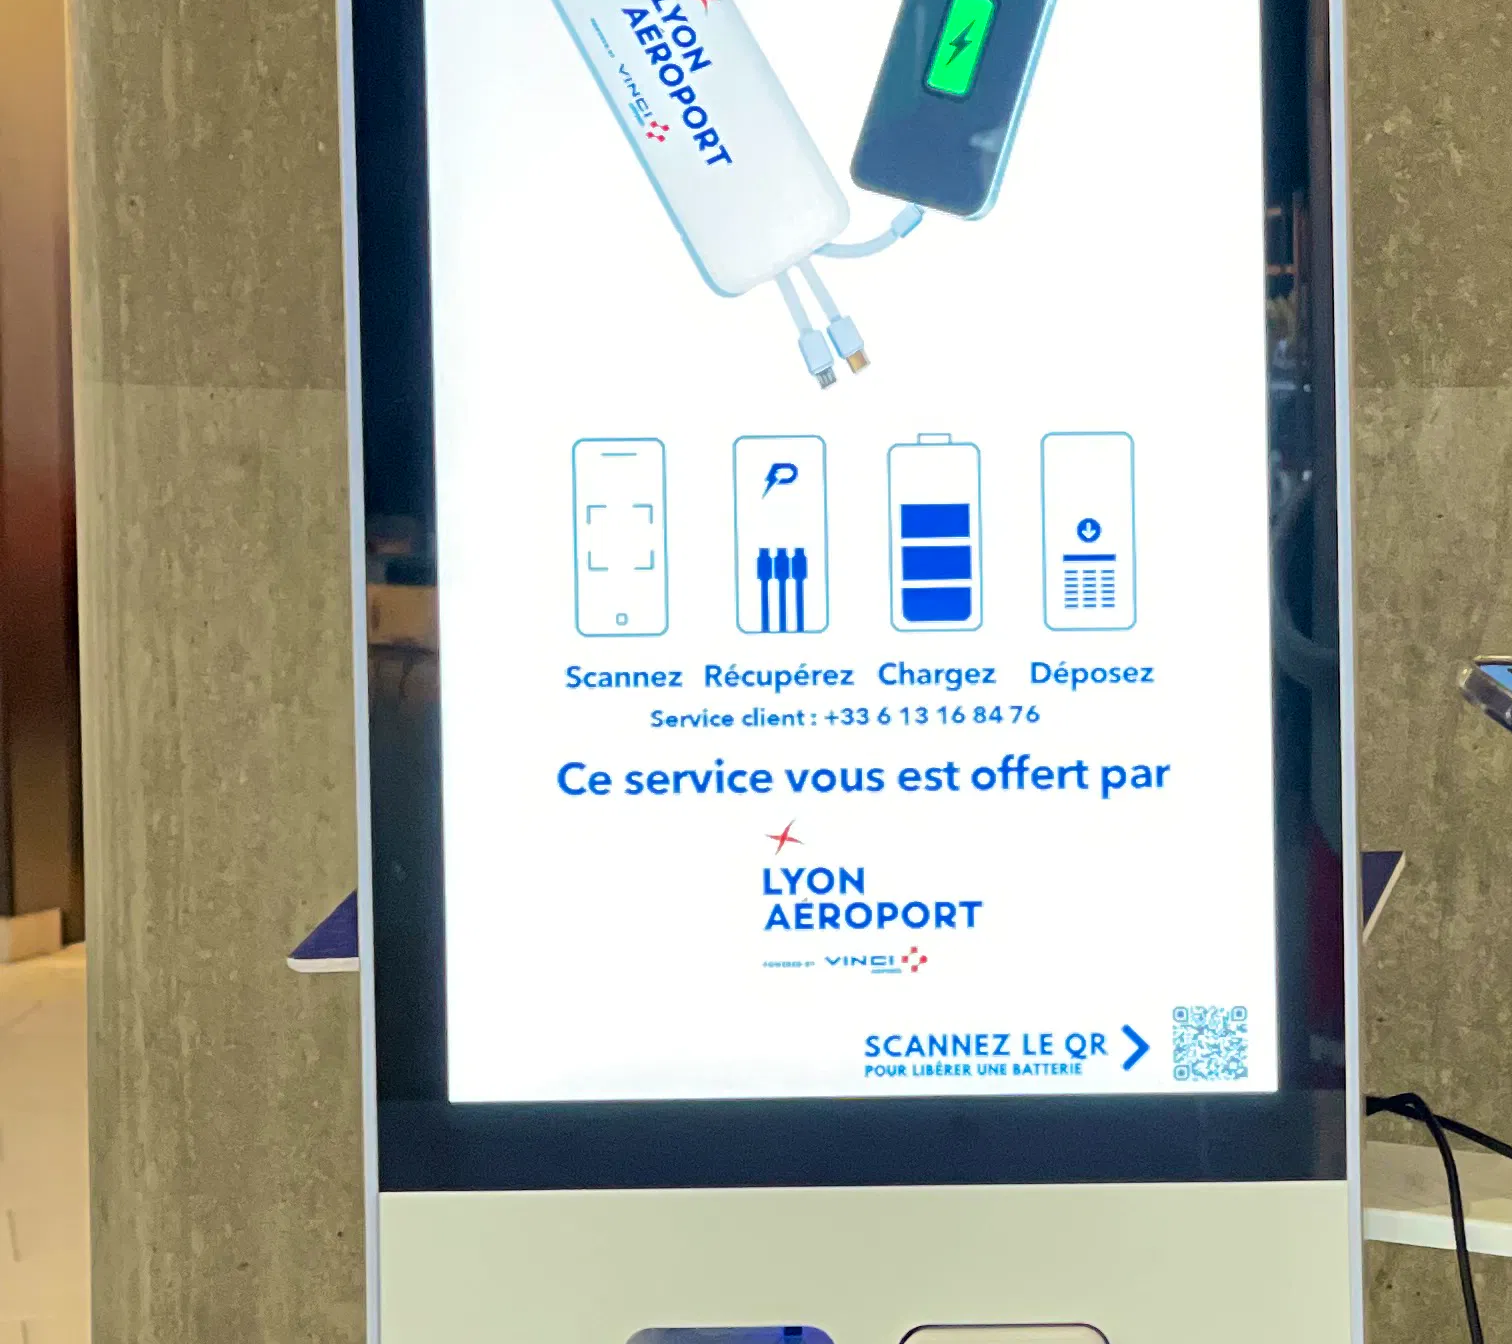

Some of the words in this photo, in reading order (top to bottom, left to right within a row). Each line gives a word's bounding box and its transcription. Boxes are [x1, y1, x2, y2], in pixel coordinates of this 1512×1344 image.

[618, 63, 653, 118] VINCI
[565, 665, 683, 689] Scannez
[704, 663, 855, 694] Récupérez
[878, 661, 997, 692] Chargez
[1030, 660, 1155, 692] Déposez
[650, 708, 735, 728] Service
[824, 707, 870, 726] +33
[876, 706, 892, 726] 6
[899, 706, 929, 726] 13
[936, 705, 967, 725] 16
[972, 705, 1004, 724] 84
[1009, 705, 1041, 724] 76
[556, 761, 613, 796] Ce
[624, 757, 773, 796] service
[784, 767, 885, 794] vous
[897, 761, 961, 792] est
[970, 753, 1089, 792] offert
[1101, 764, 1171, 800] par
[762, 866, 865, 896] LYON
[764, 897, 983, 931] AÉROPORT
[824, 954, 895, 967] VINCI
[864, 1033, 1011, 1058] SCANNEZ
[1022, 1033, 1053, 1056] LE
[1064, 1032, 1108, 1060] QR
[864, 1064, 907, 1078] POUR
[976, 1063, 1007, 1076] UNE
[1012, 1062, 1082, 1076] BATTERIE
